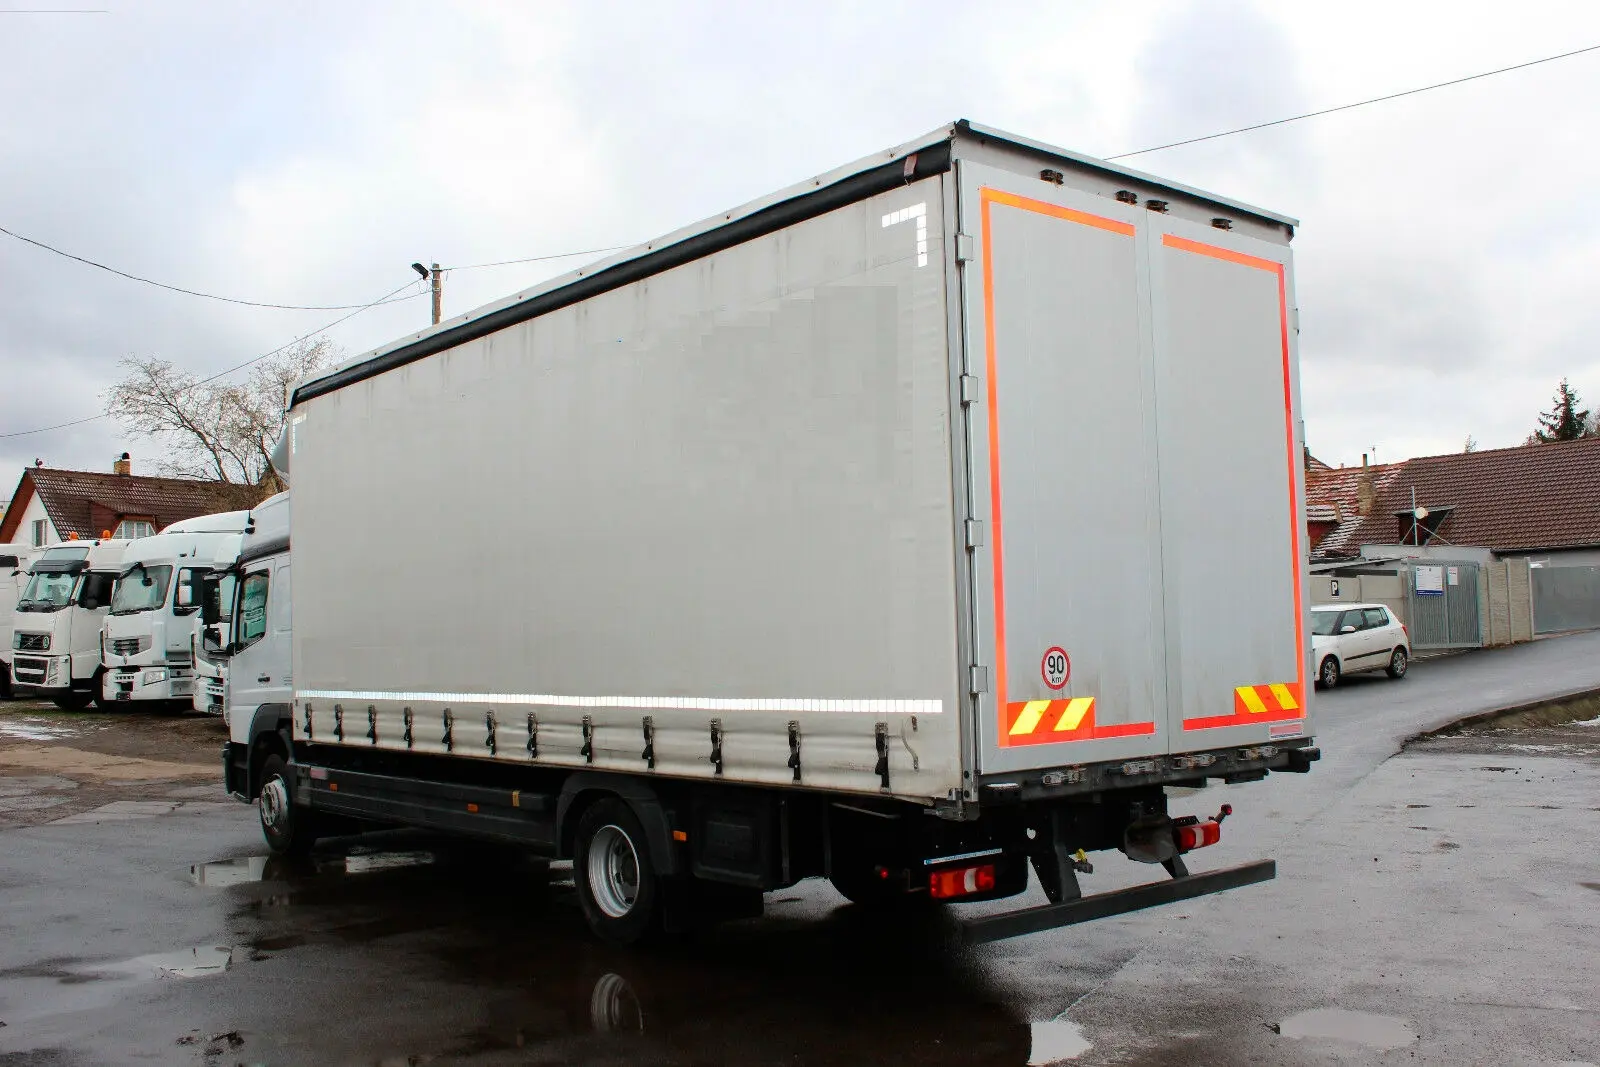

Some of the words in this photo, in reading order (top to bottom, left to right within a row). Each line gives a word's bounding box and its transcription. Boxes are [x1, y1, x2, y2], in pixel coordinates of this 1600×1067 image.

[1331, 581, 1338, 595] P
[1048, 655, 1064, 674] 90
[1051, 675, 1062, 683] km
